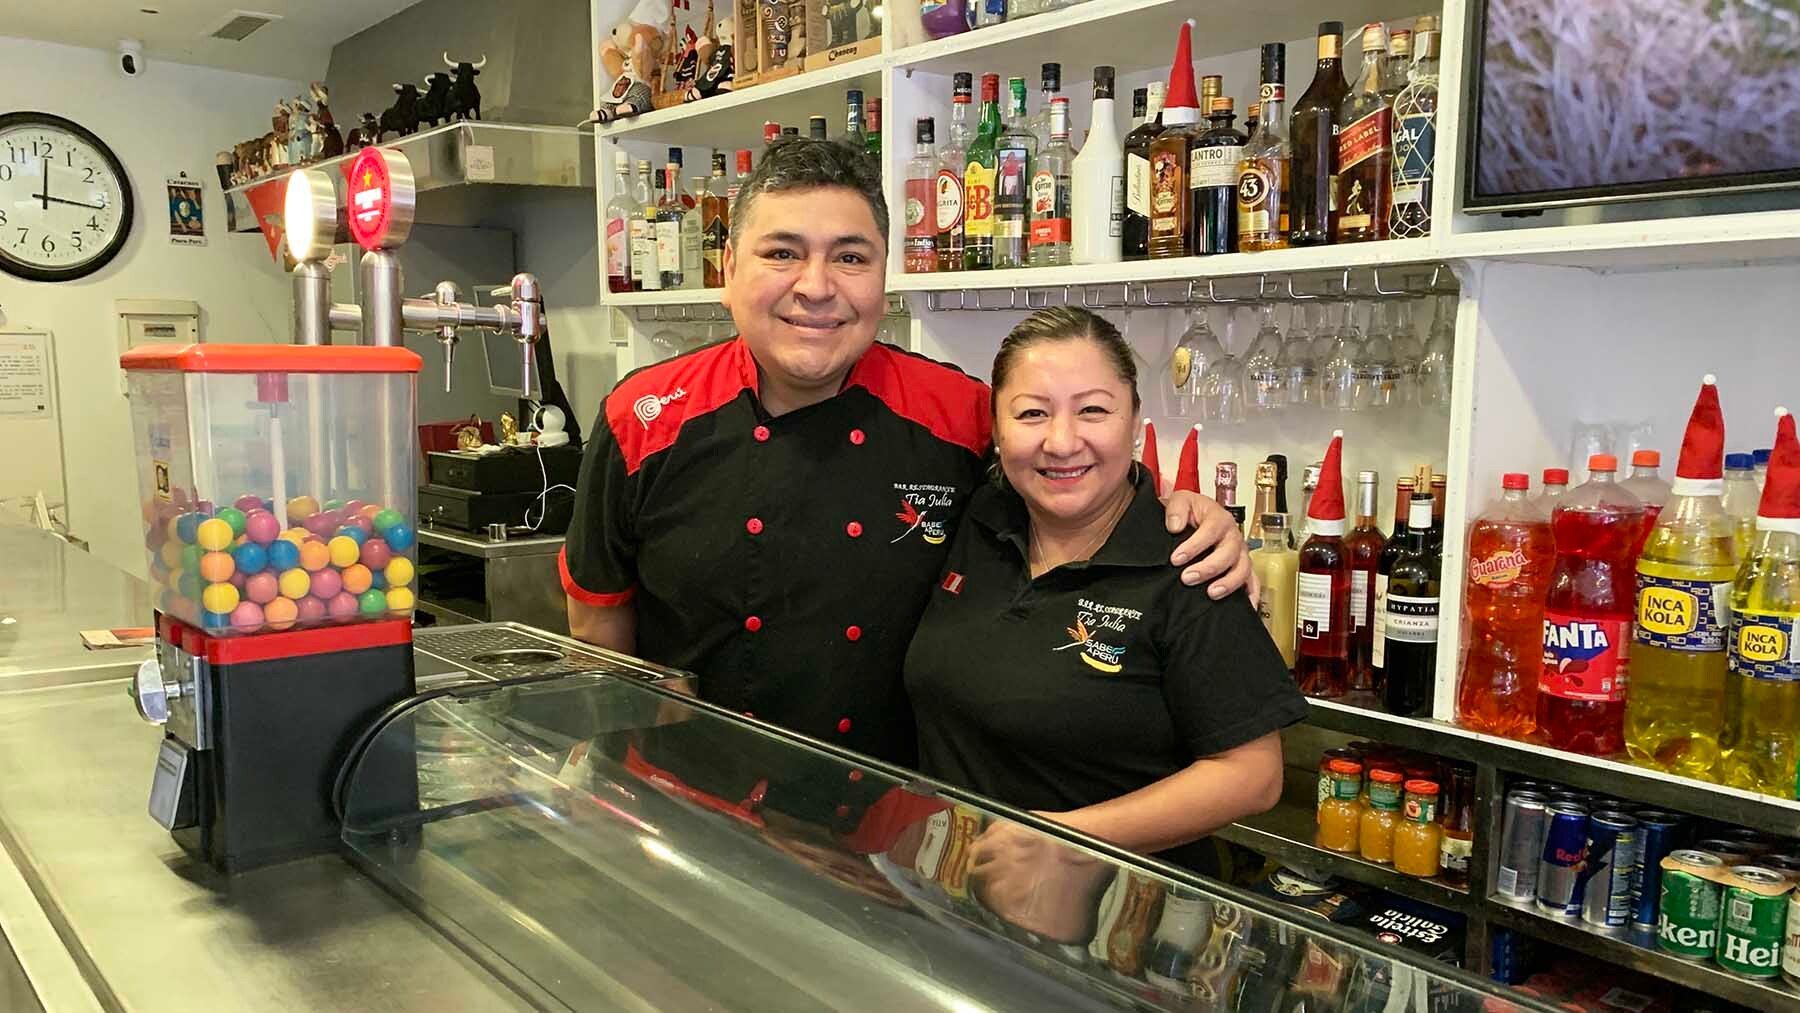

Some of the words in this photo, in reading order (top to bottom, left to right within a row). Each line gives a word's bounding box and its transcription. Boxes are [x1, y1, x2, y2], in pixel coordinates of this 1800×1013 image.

[1354, 126, 1381, 145] LABEL
[10, 146, 26, 164] 11
[33, 141, 53, 159] 12
[66, 151, 72, 167] 1
[0, 164, 12, 181] 0
[82, 167, 95, 183] 2
[1240, 178, 1258, 197] 43
[86, 215, 99, 231] 4
[17, 227, 29, 243] 7
[41, 234, 55, 253] 6
[71, 231, 82, 247] 5
[928, 492, 952, 507] Julia
[1390, 603, 1435, 613] HYPATIA
[1647, 594, 1684, 612] INCA
[1096, 614, 1126, 633] Julia
[1644, 609, 1685, 626] KOLA
[1543, 620, 1608, 649] FANTA
[1747, 632, 1777, 644] INCA
[1085, 639, 1113, 654] SABE
[1744, 641, 1778, 655] KOLA
[1370, 914, 1442, 943] Estrella
[1384, 909, 1448, 935] Galicia
[1724, 933, 1779, 967] Hei
